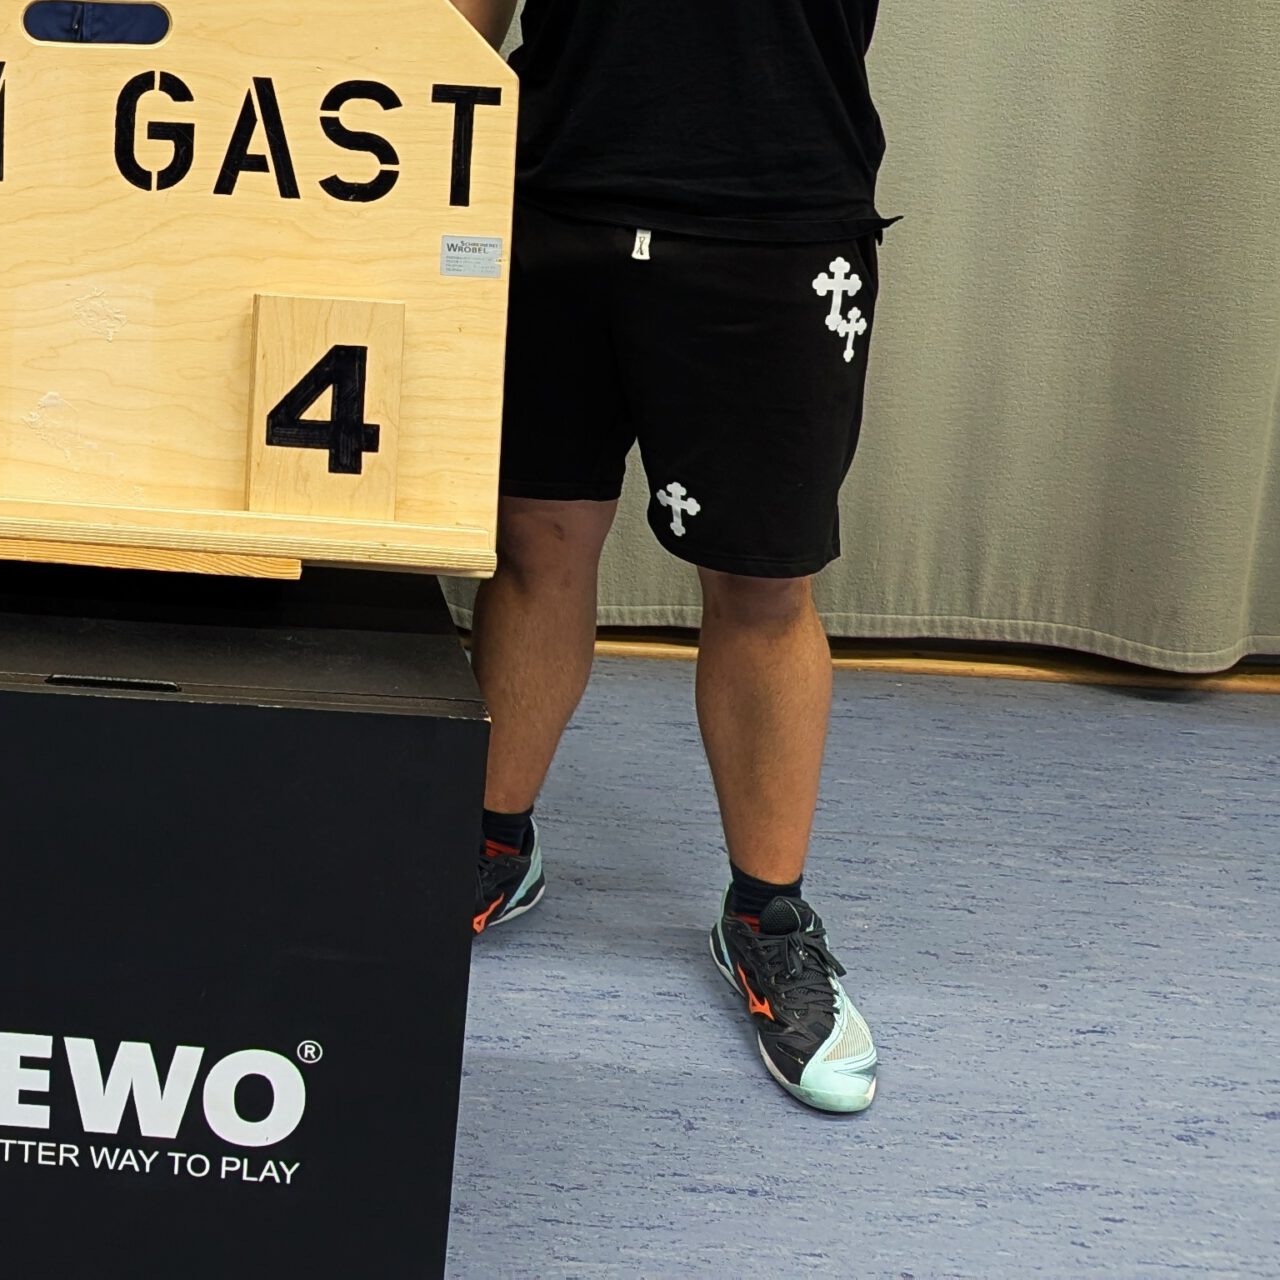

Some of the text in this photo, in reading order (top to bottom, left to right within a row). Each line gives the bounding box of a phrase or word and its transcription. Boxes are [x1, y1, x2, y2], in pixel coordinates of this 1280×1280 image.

[114, 70, 502, 207] GAST
[265, 344, 381, 475] 4
[89, 1146, 160, 1173] WAY
[167, 1151, 211, 1178] TO
[220, 1156, 300, 1185] PLAY
